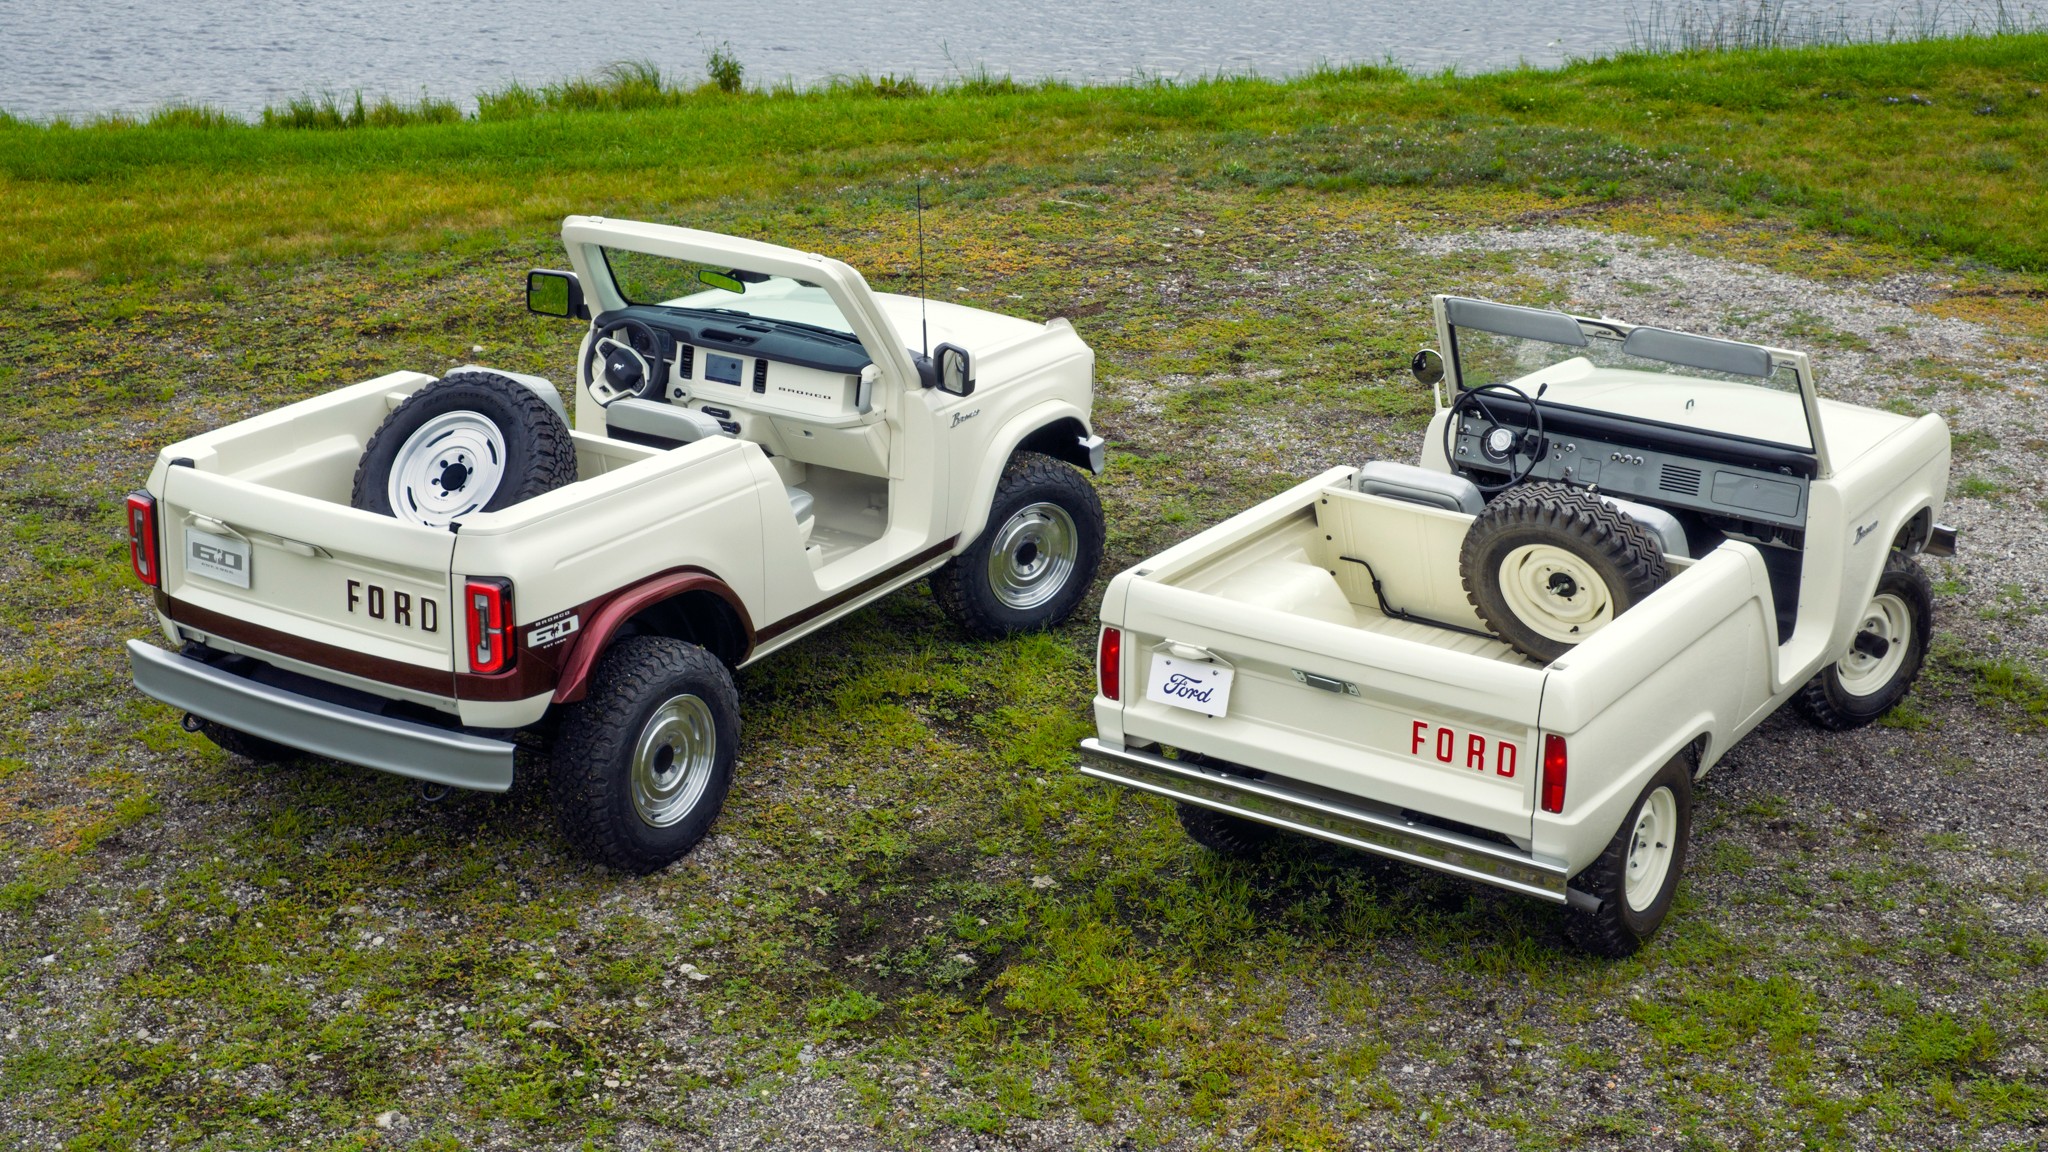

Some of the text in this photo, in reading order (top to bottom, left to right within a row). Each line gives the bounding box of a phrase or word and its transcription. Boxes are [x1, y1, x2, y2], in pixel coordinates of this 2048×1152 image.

[778, 386, 831, 400] BRONCO
[347, 579, 438, 632] FORD
[535, 610, 571, 627] BRONCO
[1163, 673, 1214, 703] Ford
[1411, 720, 1517, 778] FORD
